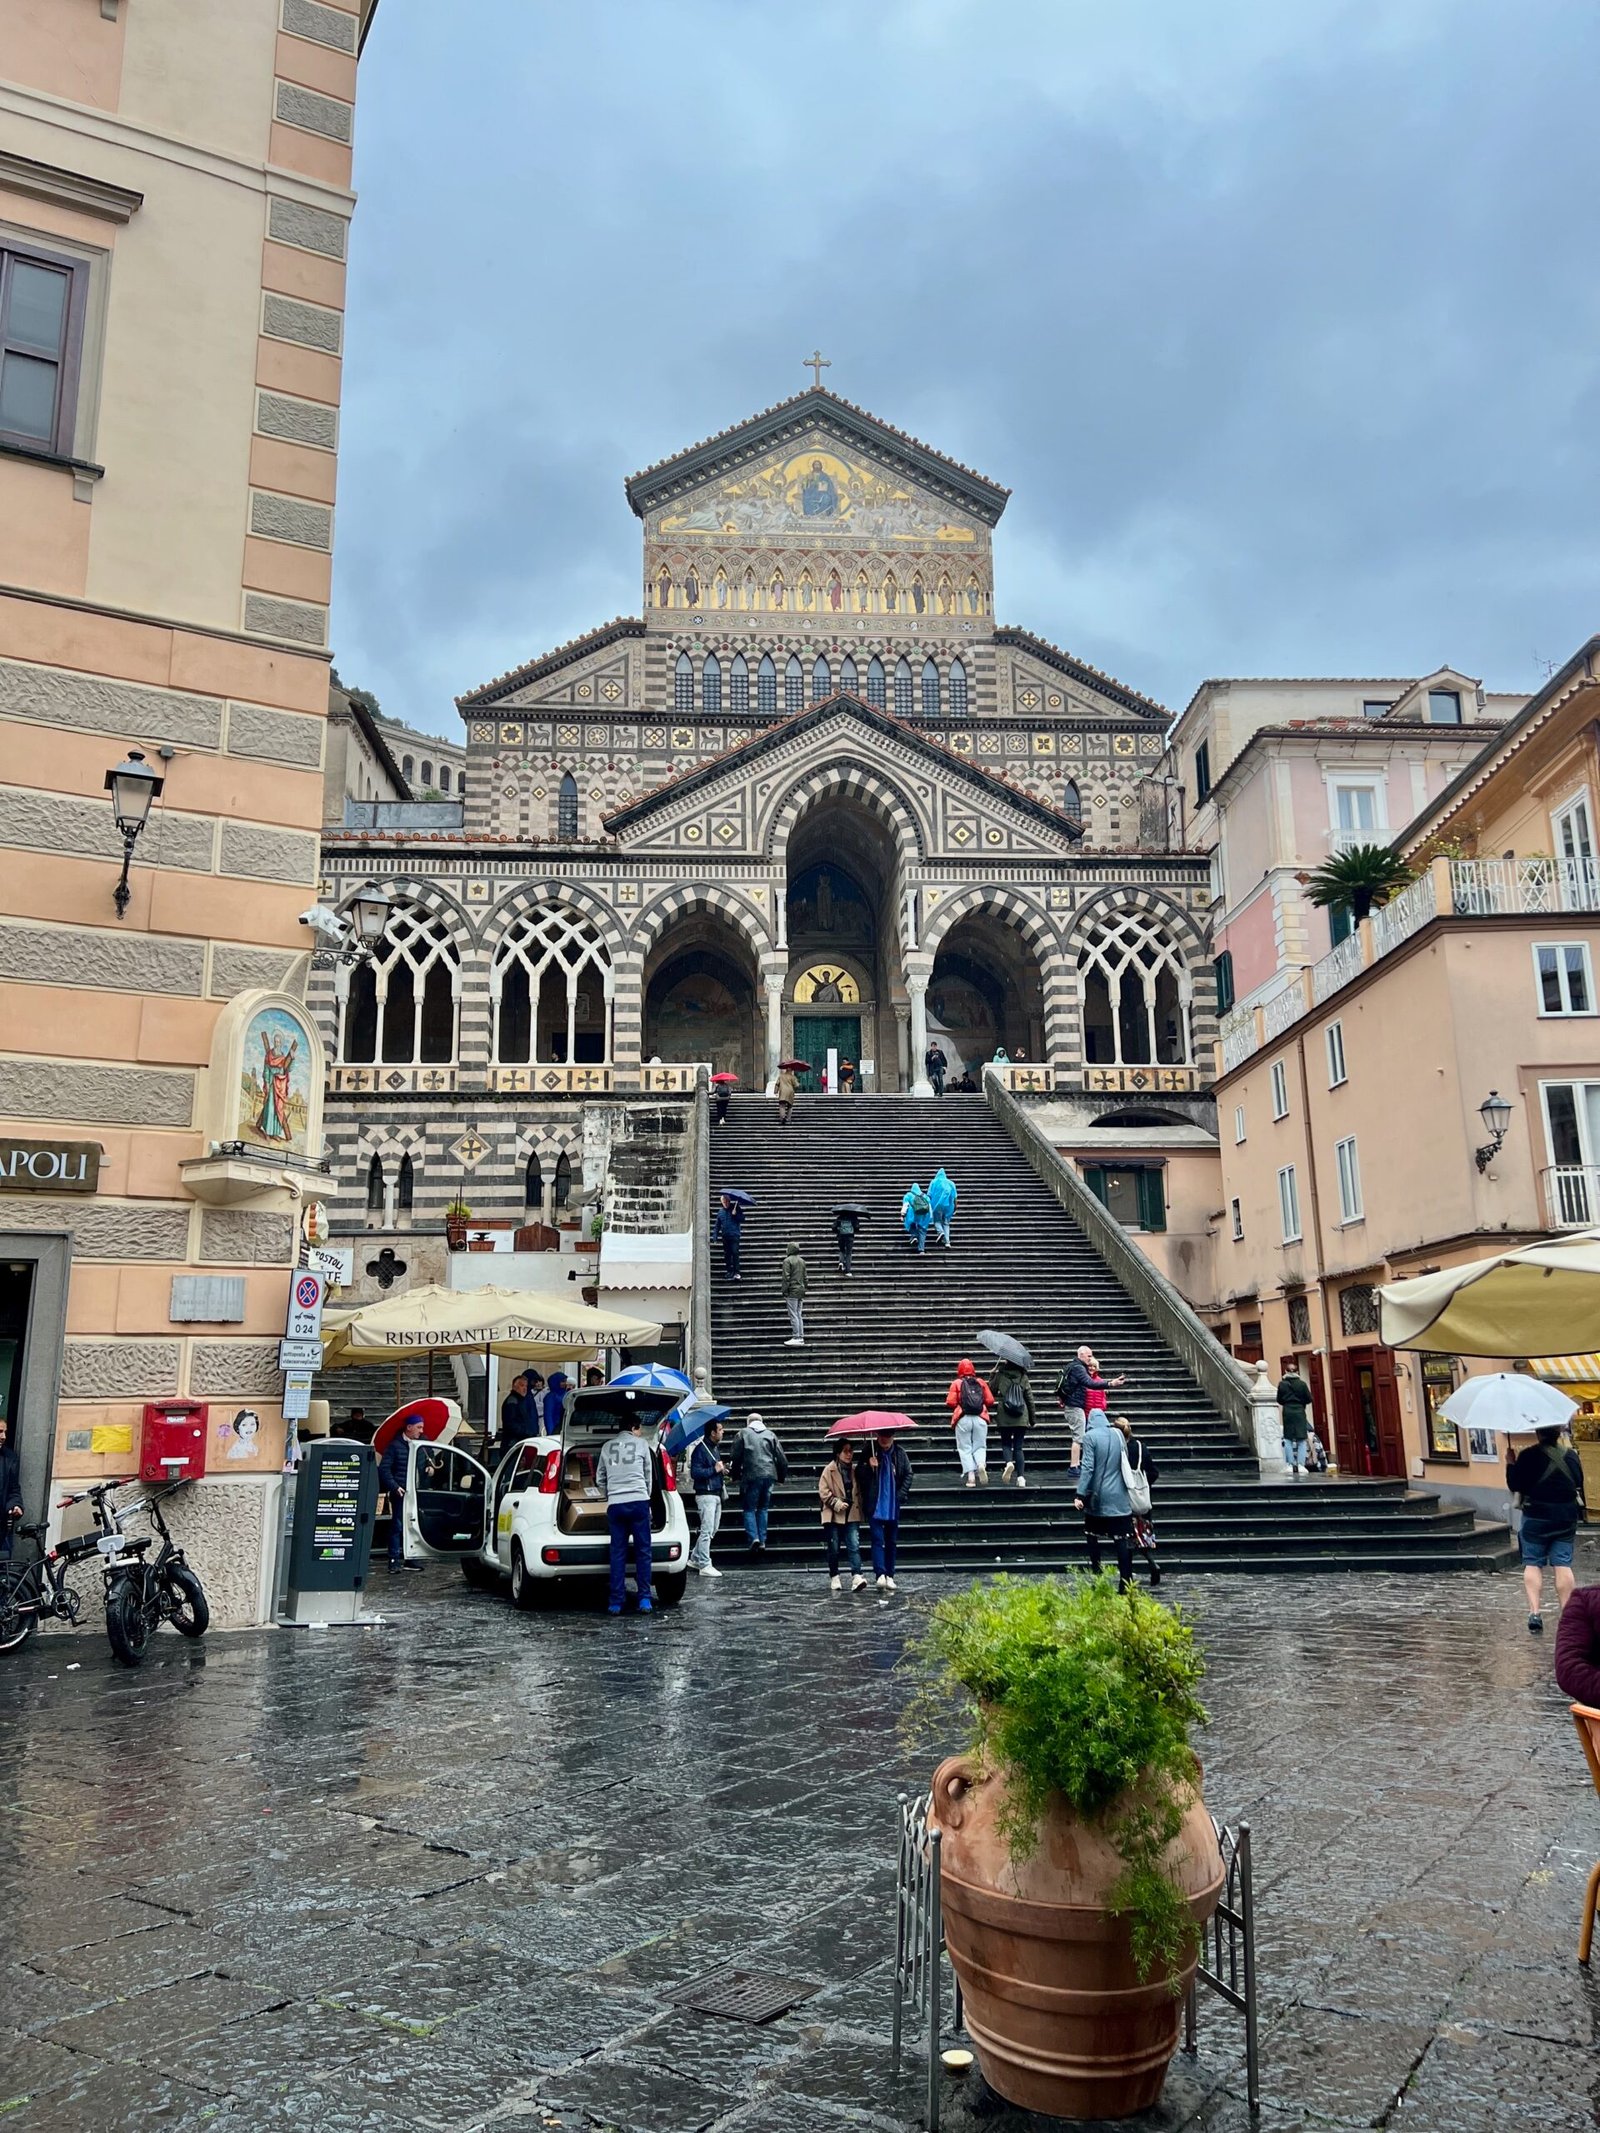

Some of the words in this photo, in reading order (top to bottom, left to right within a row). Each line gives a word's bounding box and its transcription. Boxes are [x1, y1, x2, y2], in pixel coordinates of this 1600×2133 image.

[313, 1250, 344, 1270] POSTOLI
[385, 1327, 500, 1345] RISTORANTE
[508, 1325, 586, 1345] PIZZERIA
[595, 1331, 628, 1345] BAR
[608, 1442, 637, 1466] 53
